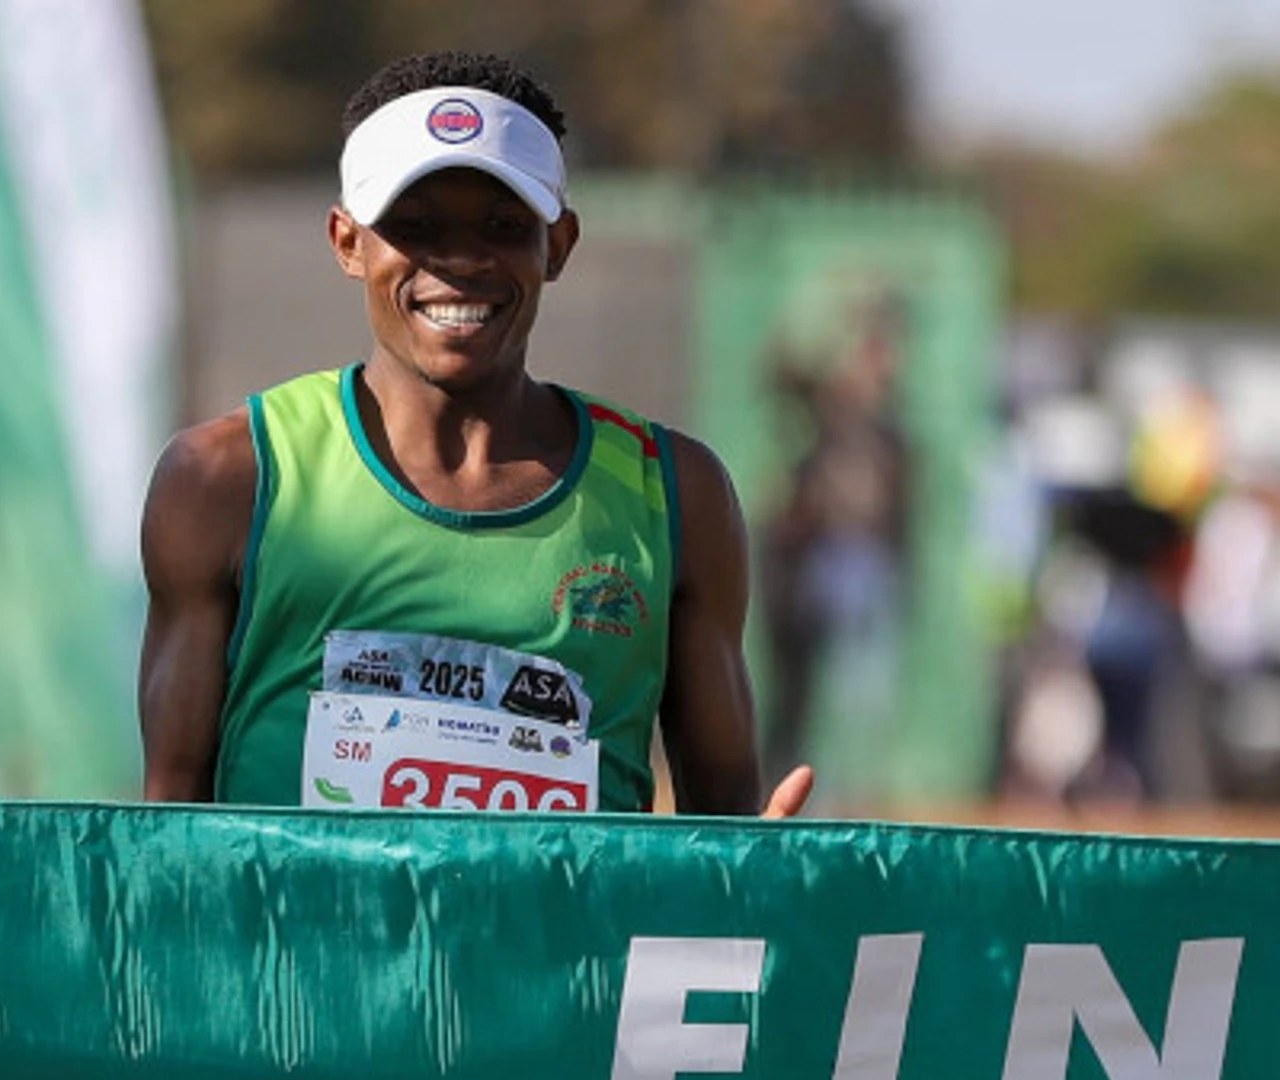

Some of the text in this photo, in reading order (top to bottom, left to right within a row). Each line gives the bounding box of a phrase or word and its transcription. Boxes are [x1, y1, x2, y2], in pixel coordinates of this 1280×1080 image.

[419, 658, 485, 702] 2025
[513, 664, 571, 703] ASA
[333, 739, 372, 763] SM
